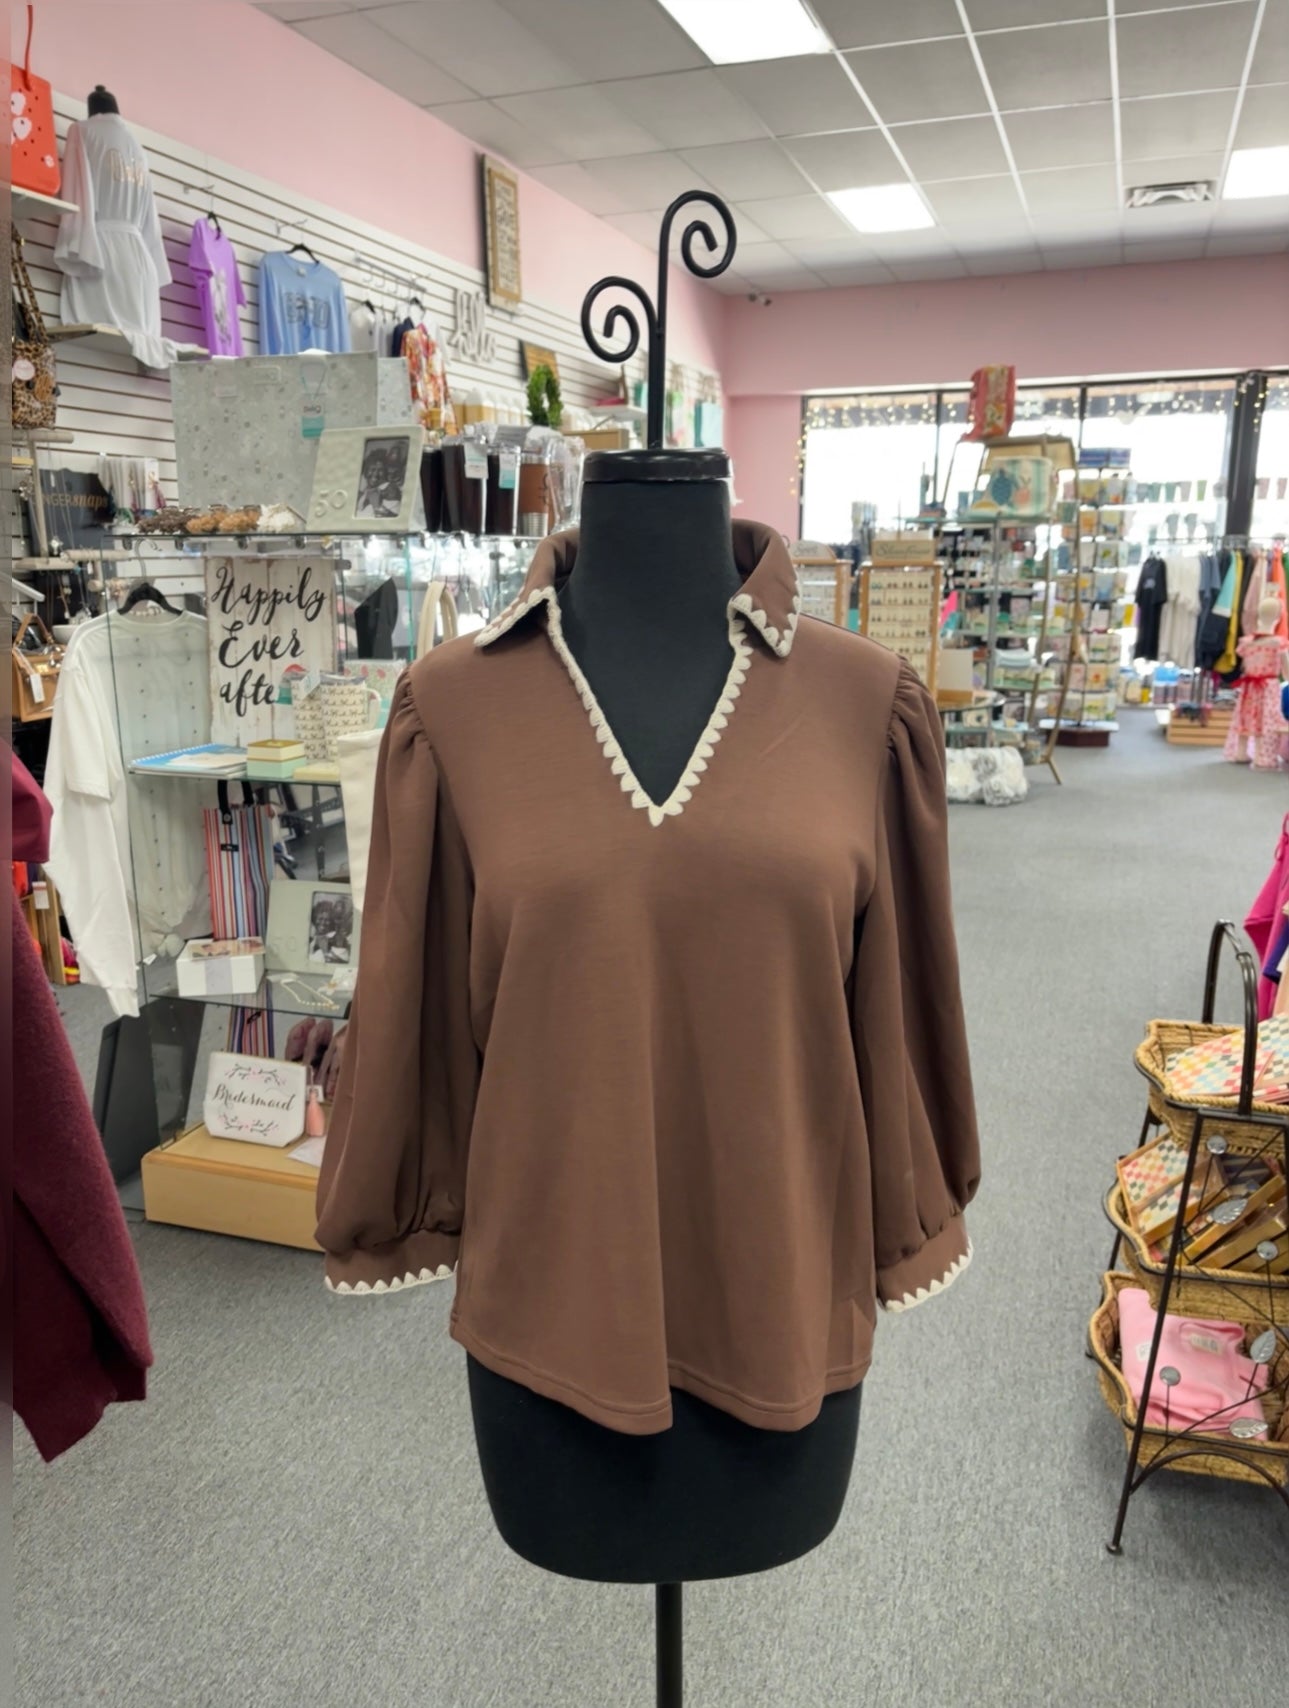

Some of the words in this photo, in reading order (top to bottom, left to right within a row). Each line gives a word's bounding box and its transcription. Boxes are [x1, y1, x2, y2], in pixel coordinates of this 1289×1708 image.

[211, 566, 327, 625] Happily
[218, 620, 304, 669] Ever
[219, 669, 277, 718] afte
